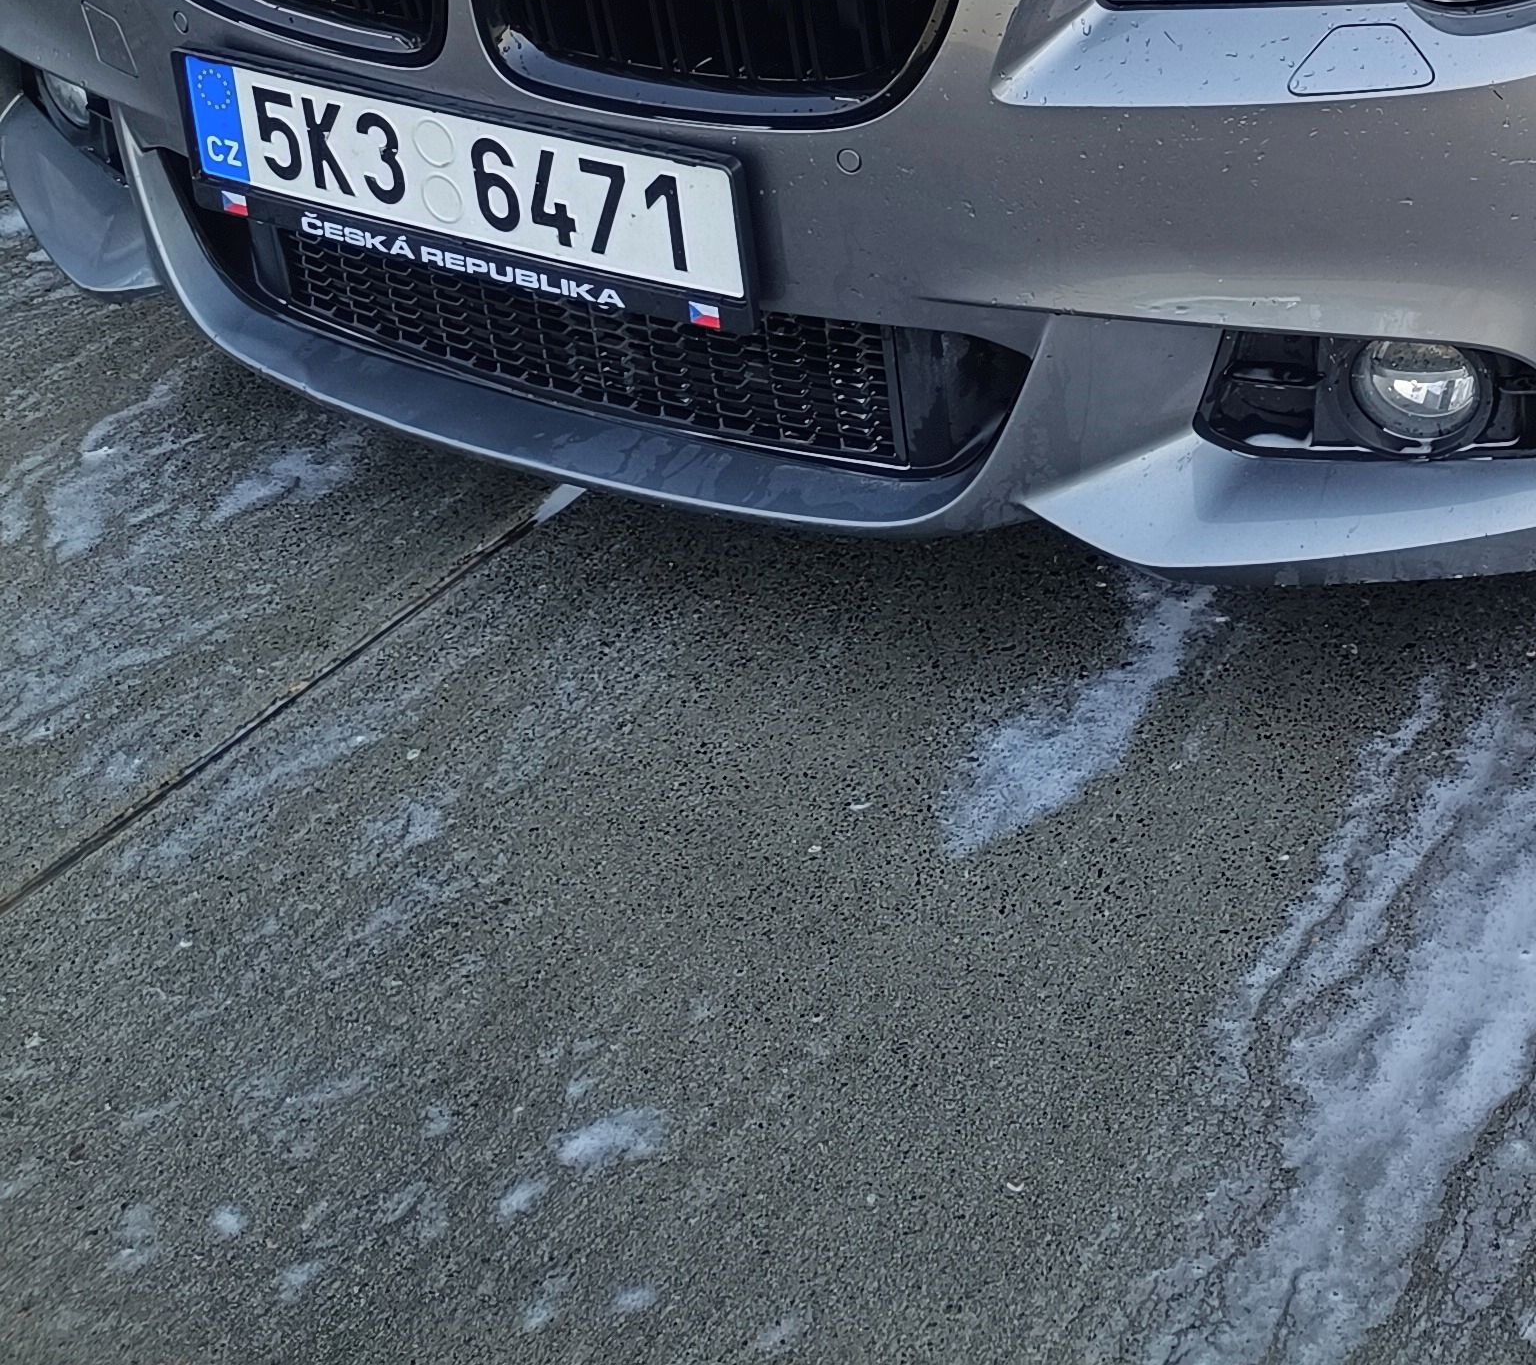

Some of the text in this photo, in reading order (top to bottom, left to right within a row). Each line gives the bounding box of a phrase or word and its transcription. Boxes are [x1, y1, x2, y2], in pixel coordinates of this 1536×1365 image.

[206, 135, 243, 168] CZ
[251, 85, 689, 272] 5K3 6471
[300, 212, 626, 309] ČESKÁ REPUBLIKA
